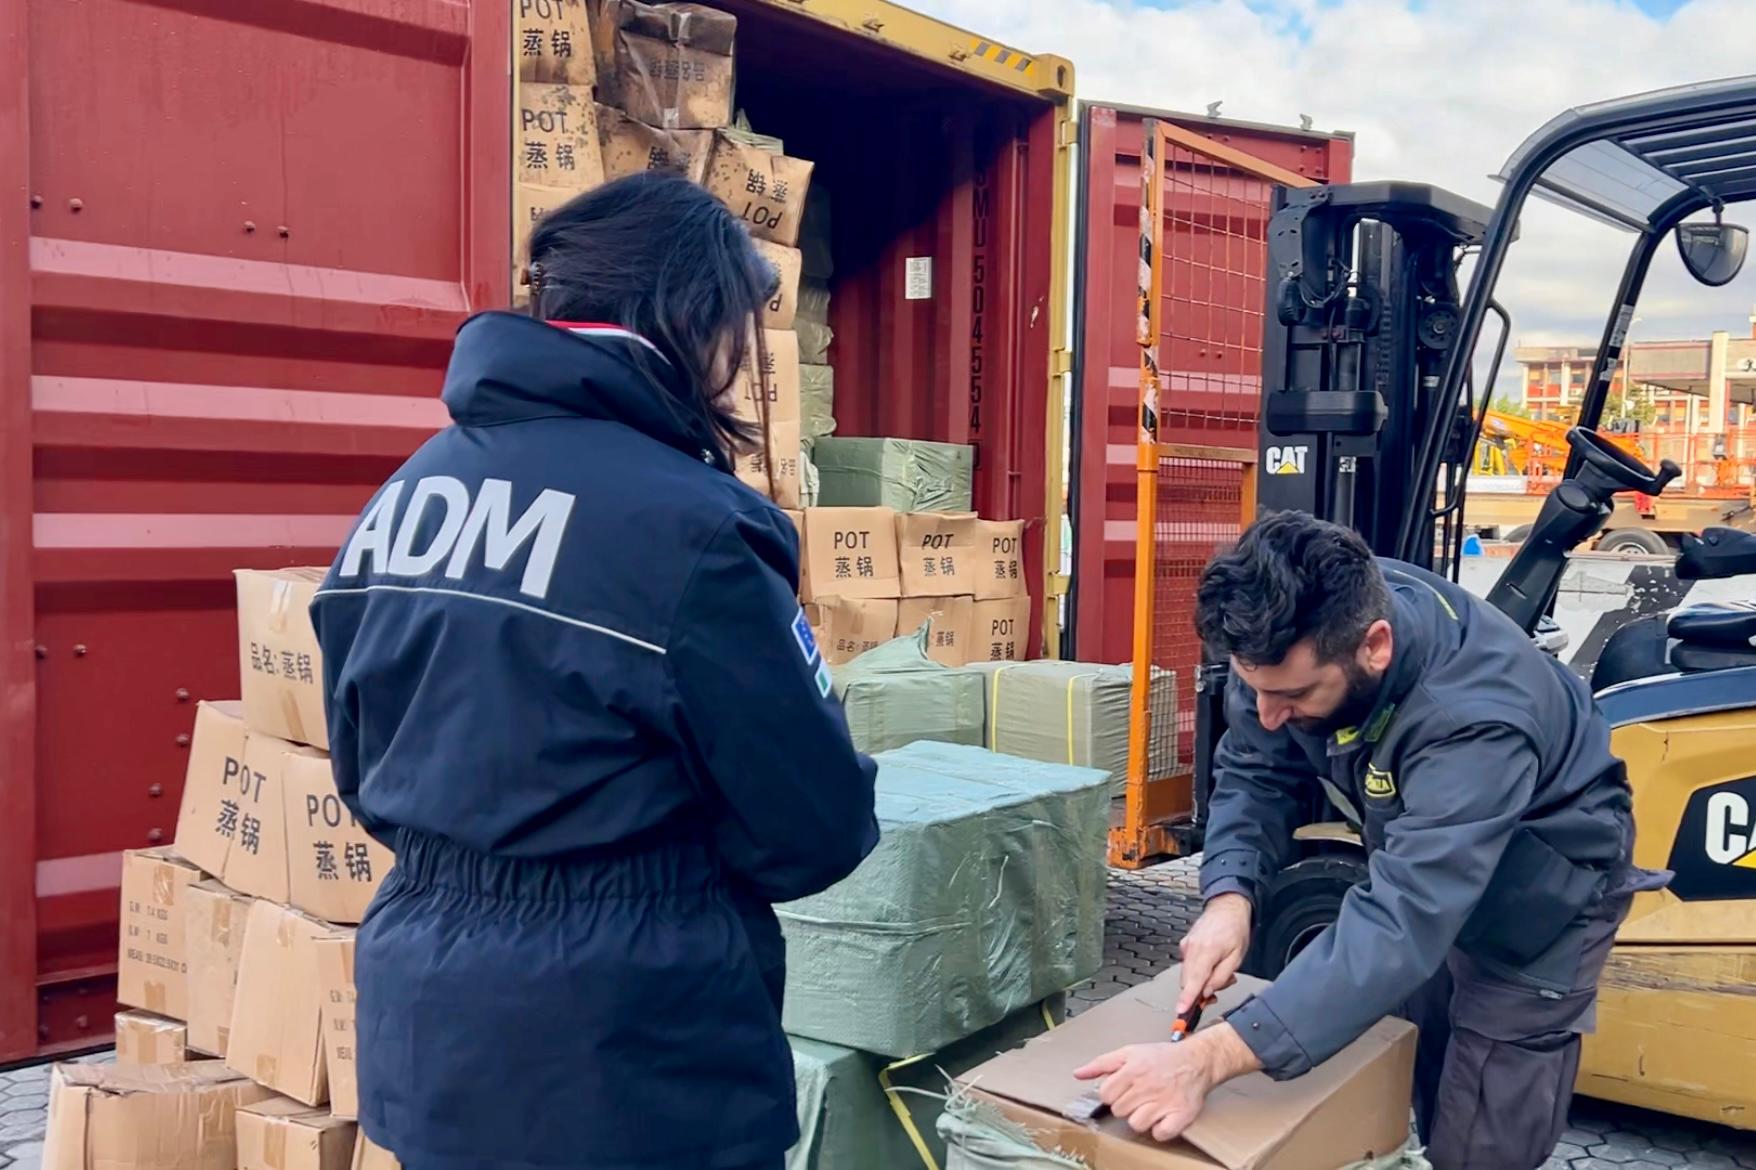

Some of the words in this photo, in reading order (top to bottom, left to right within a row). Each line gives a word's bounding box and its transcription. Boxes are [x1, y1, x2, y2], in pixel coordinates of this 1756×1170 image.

[520, 0, 564, 20] POT
[523, 28, 572, 57] 蒸锅
[522, 109, 567, 134] POT
[526, 142, 576, 171] 蒸锅
[740, 201, 784, 229] POT
[1266, 446, 1308, 475] CAT
[339, 475, 576, 599] ADM
[834, 531, 870, 550] POT
[921, 533, 954, 550] POT
[992, 537, 1018, 554] POT
[834, 556, 874, 578] 蒸锅
[923, 556, 956, 577] 蒸锅
[991, 618, 1015, 636] POT
[222, 757, 267, 804] POT
[215, 799, 261, 856] 蒸锅
[1705, 791, 1756, 865] C
[313, 841, 373, 883] 蒸锅
